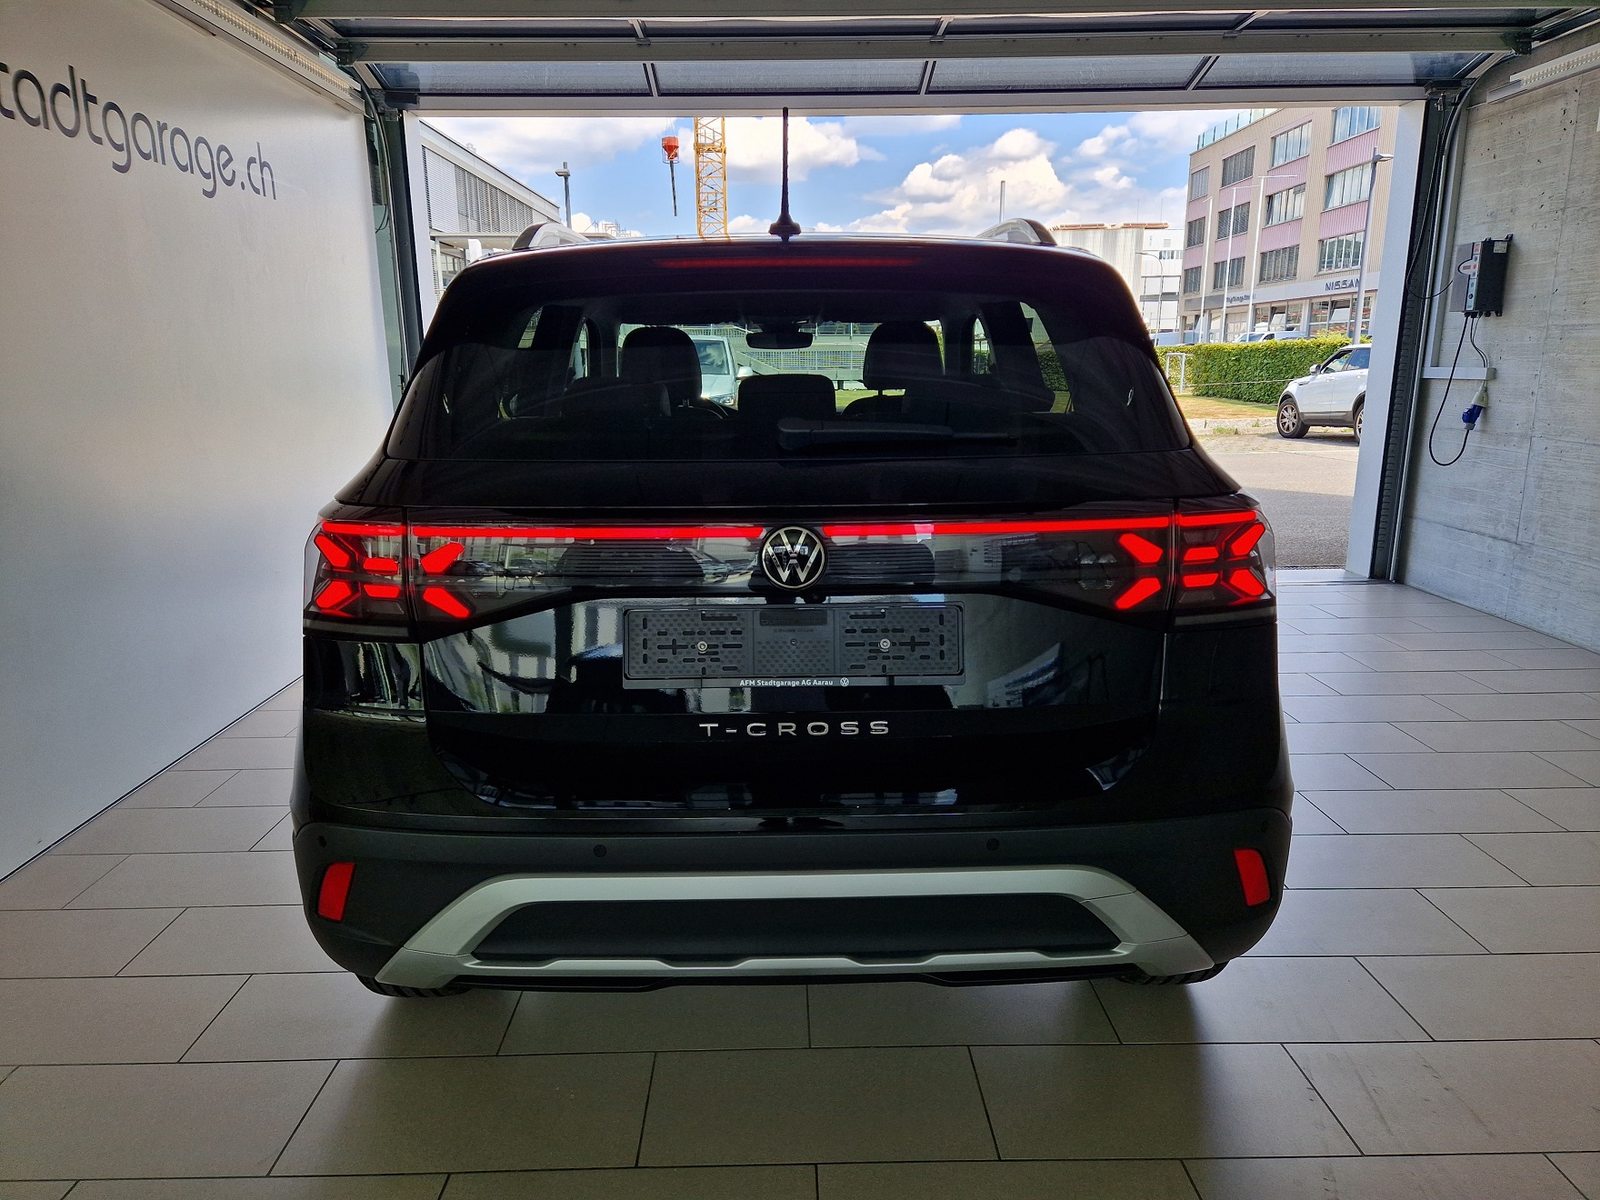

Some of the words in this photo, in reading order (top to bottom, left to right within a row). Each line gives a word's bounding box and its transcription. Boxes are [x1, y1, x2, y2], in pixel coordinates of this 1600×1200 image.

[1325, 278, 1360, 291] NISSAN
[756, 679, 800, 688] Stadtgarage
[801, 679, 812, 687] AG
[812, 679, 834, 687] Aarau
[699, 721, 890, 737] T-CROSS
